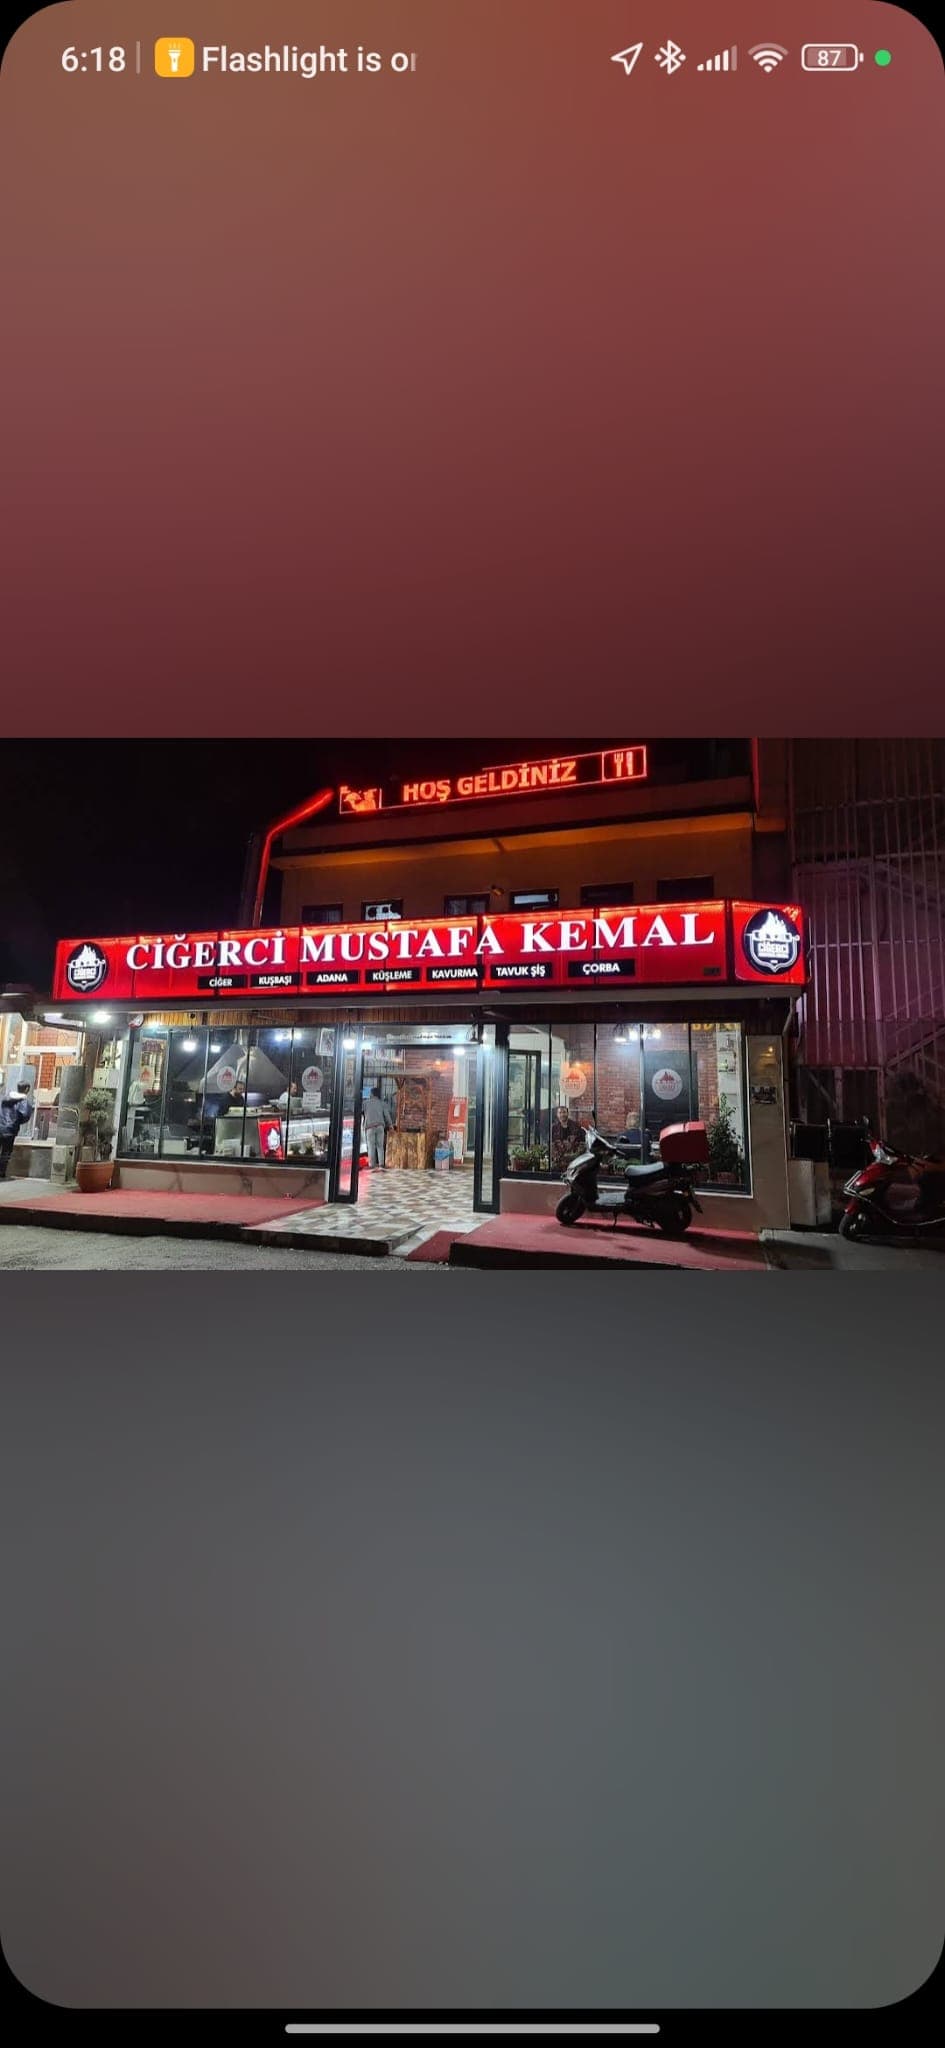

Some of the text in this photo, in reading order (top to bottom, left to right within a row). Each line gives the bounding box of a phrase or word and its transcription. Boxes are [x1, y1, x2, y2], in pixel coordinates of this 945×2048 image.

[402, 760, 578, 802] HOŞ GELDİNİZ
[125, 911, 715, 971] CİĞERCİ MUSTAFA KEMAL
[431, 967, 479, 979] KAVURMA
[495, 963, 546, 978] TAVUK ŞİŞ
[582, 962, 621, 976] ÇORBA
[208, 976, 233, 988] CİĞER
[258, 975, 292, 988] KUŞBAŞI
[316, 973, 348, 983] ADANA
